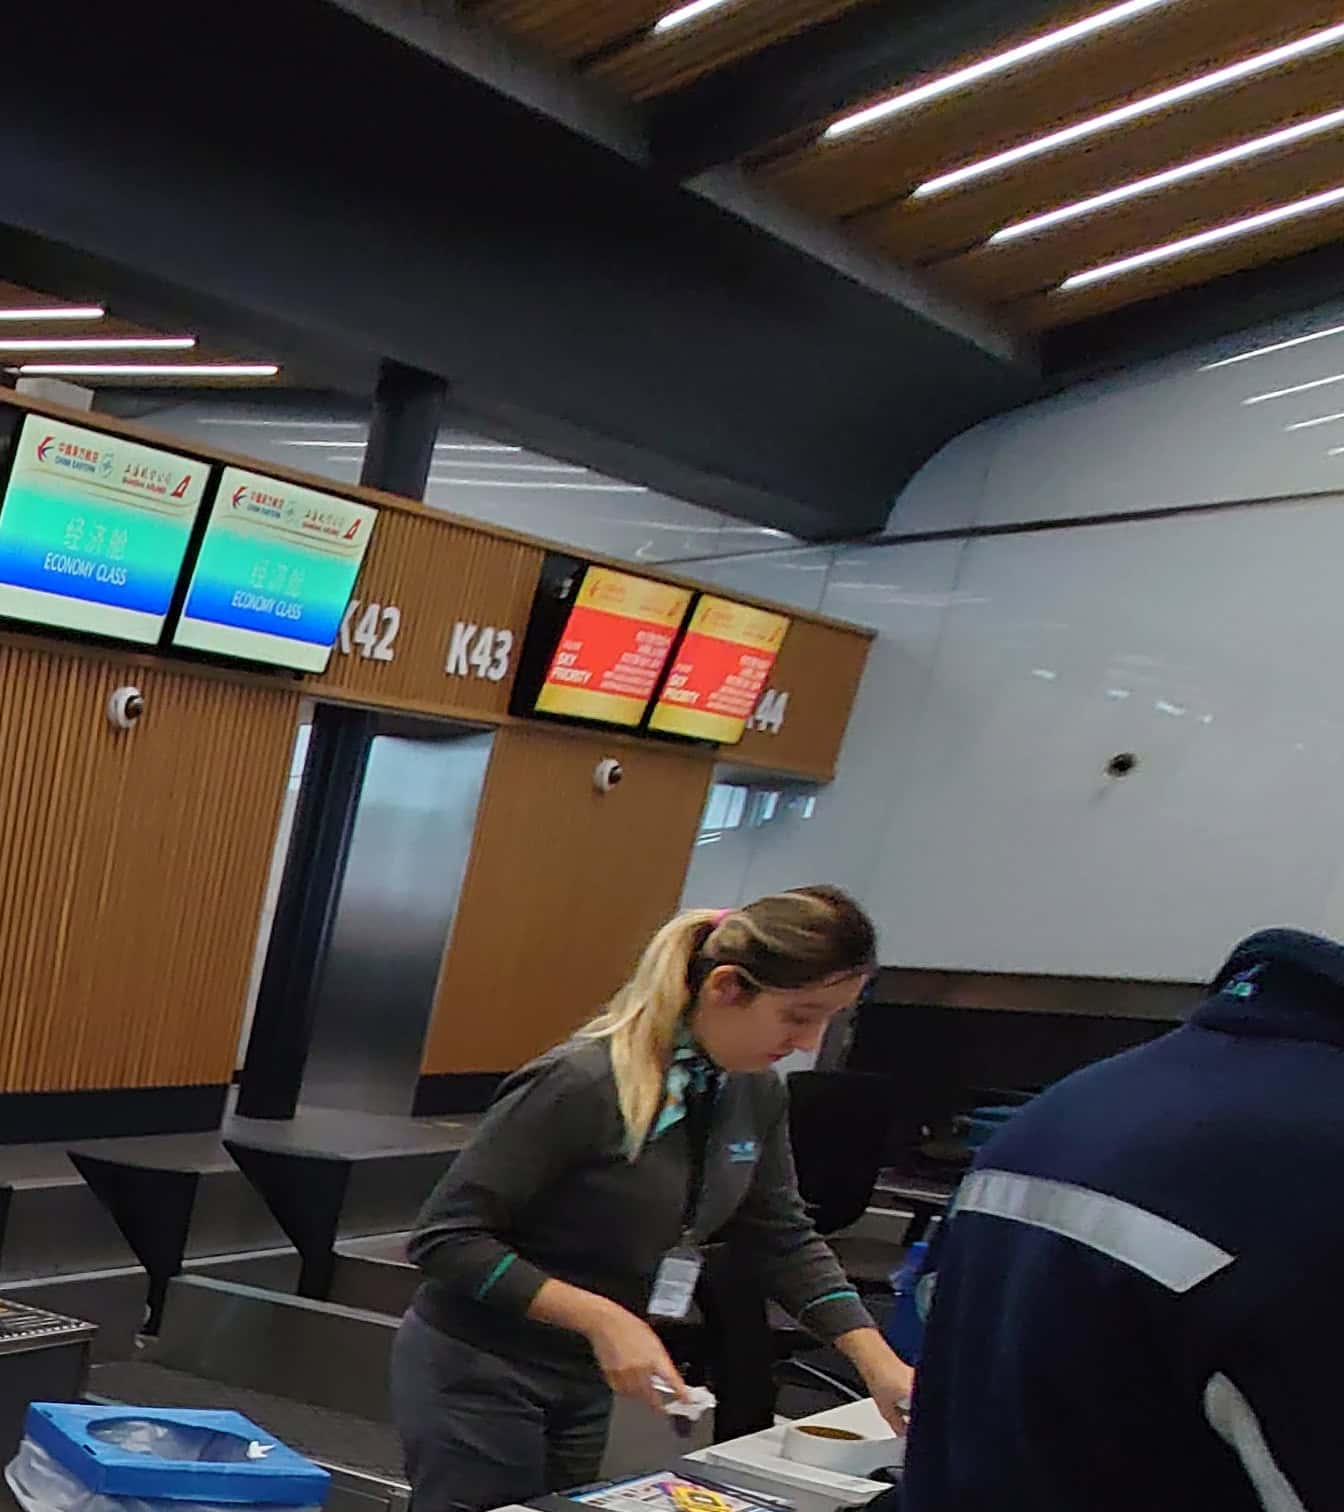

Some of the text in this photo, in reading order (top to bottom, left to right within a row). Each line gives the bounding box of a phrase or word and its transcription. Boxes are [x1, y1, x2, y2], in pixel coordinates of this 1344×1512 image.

[43, 552, 129, 586] ECONOMY CLASS
[445, 621, 514, 682] K43
[746, 688, 789, 734] 44
